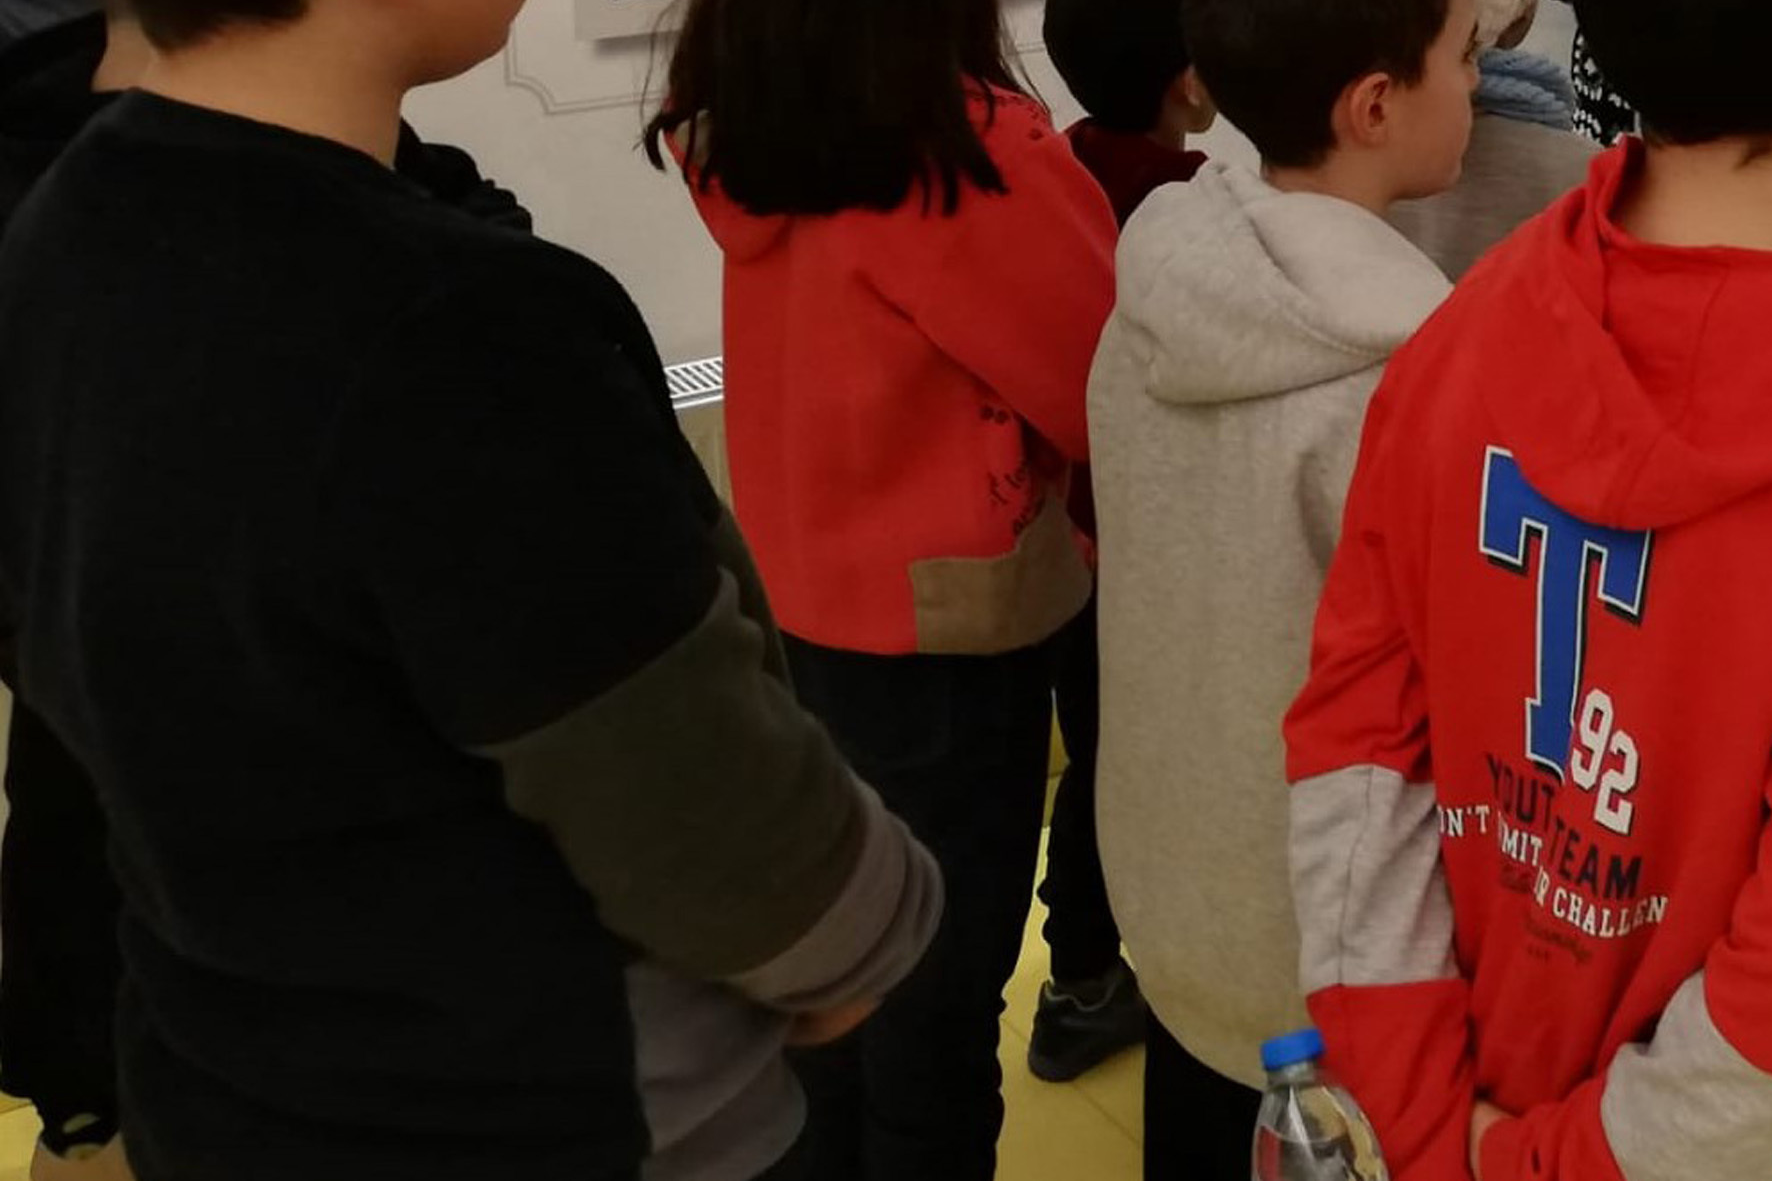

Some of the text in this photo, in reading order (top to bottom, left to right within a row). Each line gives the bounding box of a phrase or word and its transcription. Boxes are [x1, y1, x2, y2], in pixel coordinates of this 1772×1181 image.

[1479, 445, 1655, 785] T
[1486, 752, 1643, 901] YOUT TEAM
[1571, 688, 1640, 836] 92
[1552, 885, 1668, 939] CHALLEN
